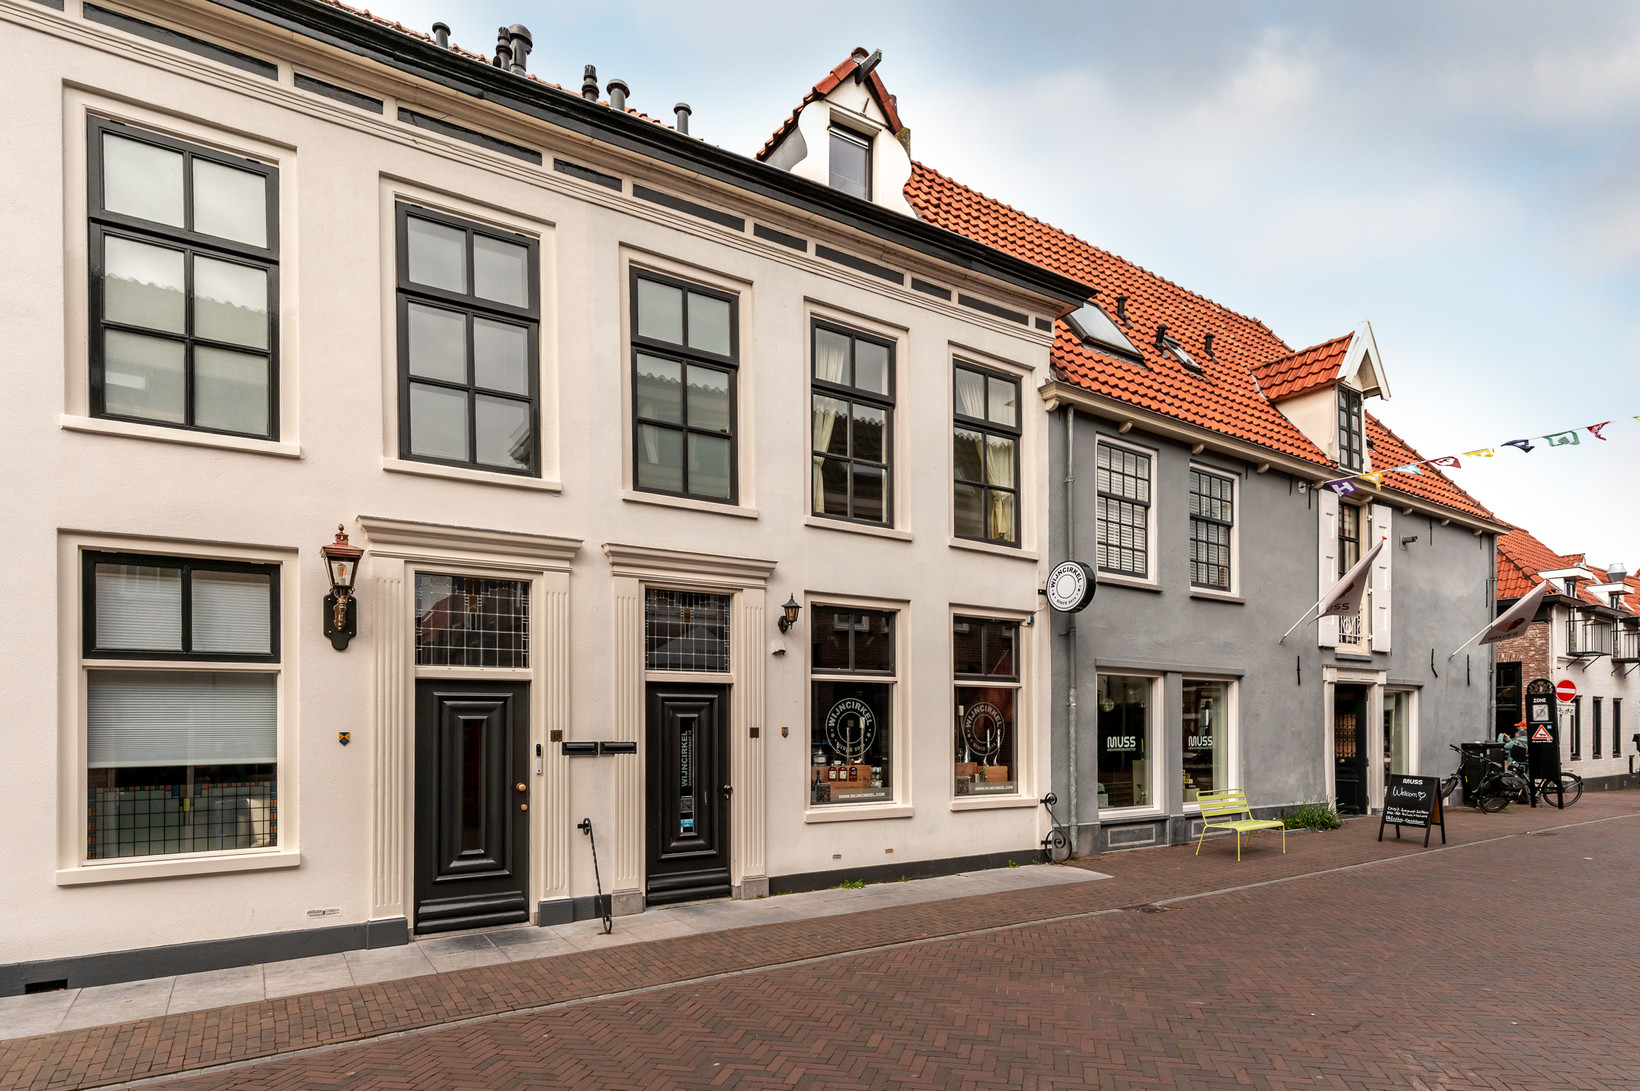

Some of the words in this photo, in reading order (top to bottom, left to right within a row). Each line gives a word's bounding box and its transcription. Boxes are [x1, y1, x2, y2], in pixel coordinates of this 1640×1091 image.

[1051, 566, 1082, 588] WIJNCIRKEL
[828, 701, 873, 727] WIJNCIRKEL
[965, 705, 1002, 728] WIJNCIRKEL
[1106, 735, 1137, 748] MUSS
[1188, 735, 1214, 747] MUSS
